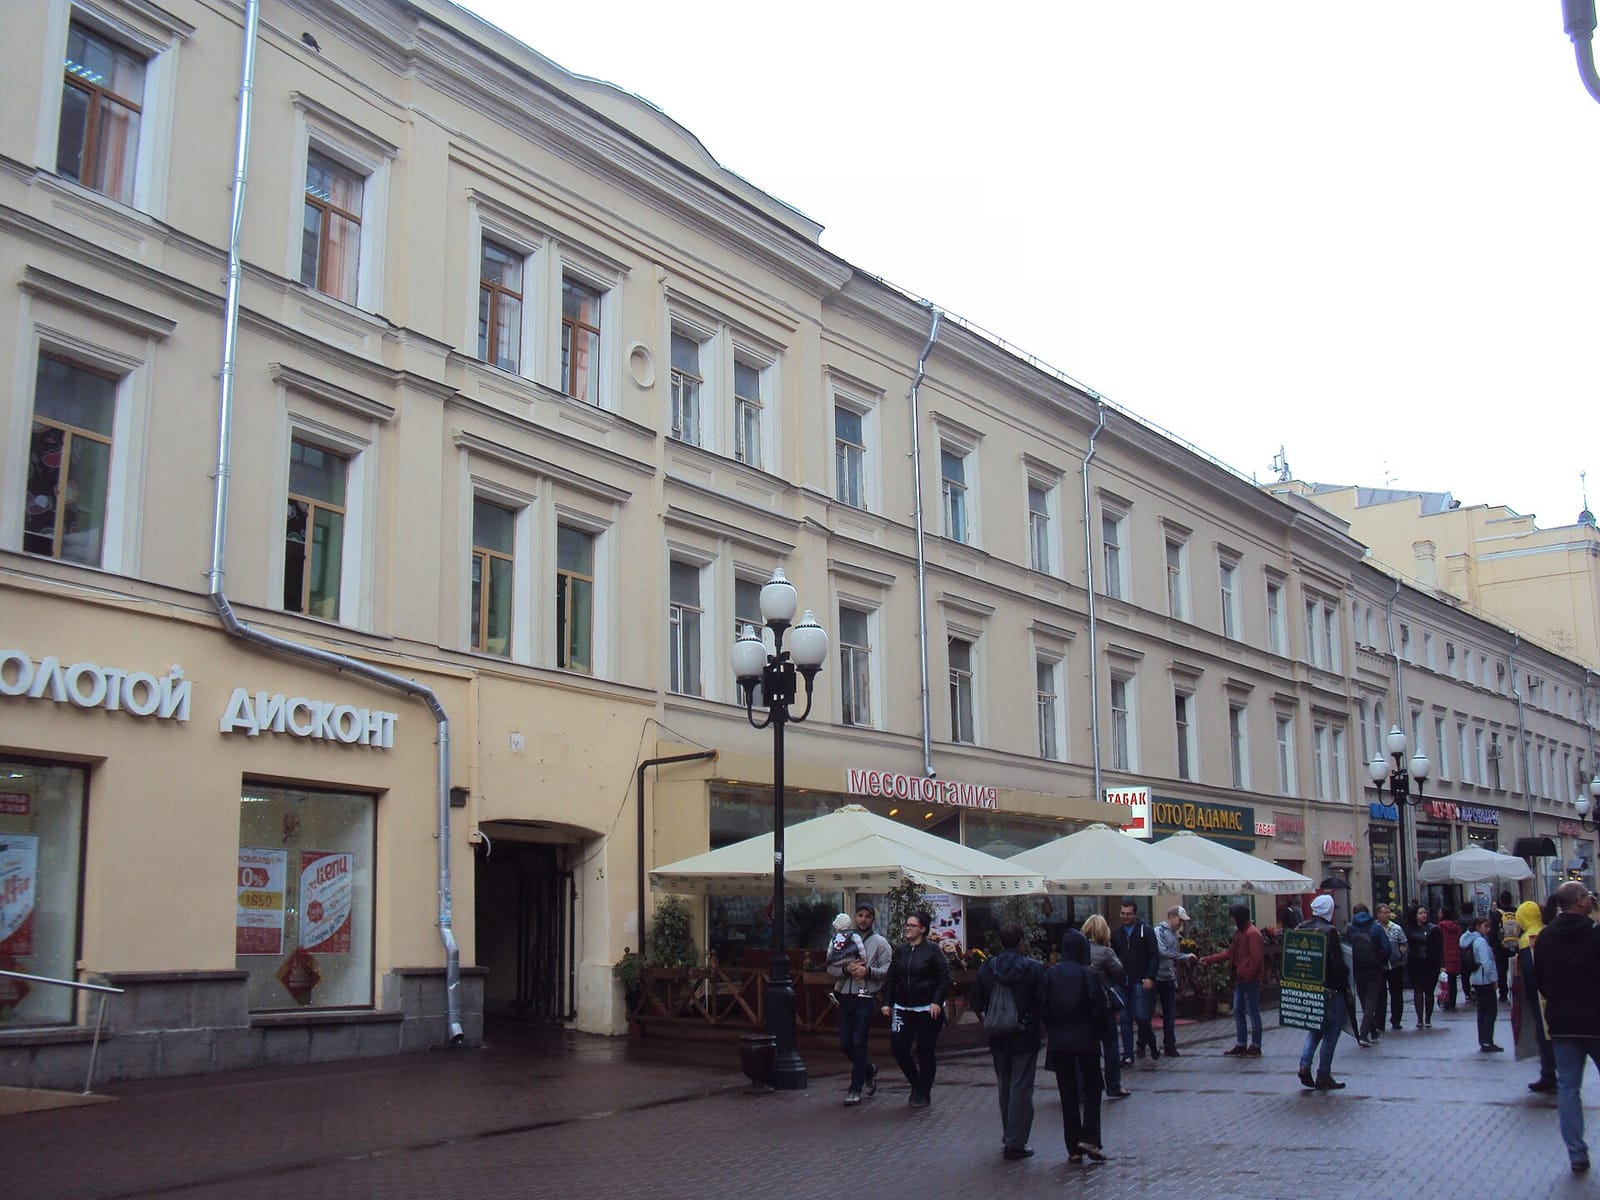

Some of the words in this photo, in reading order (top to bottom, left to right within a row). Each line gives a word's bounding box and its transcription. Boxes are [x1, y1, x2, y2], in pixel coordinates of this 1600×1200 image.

[219, 687, 398, 749] ДИСКОНТ
[1107, 792, 1146, 805] ТАБАК
[1197, 807, 1243, 832] АДАМАС
[1281, 989, 1325, 1001] АНТИКВАРИАТА
[1281, 996, 1302, 1005] ЗОЛОТА
[1302, 999, 1325, 1008] СЕРЕБРА
